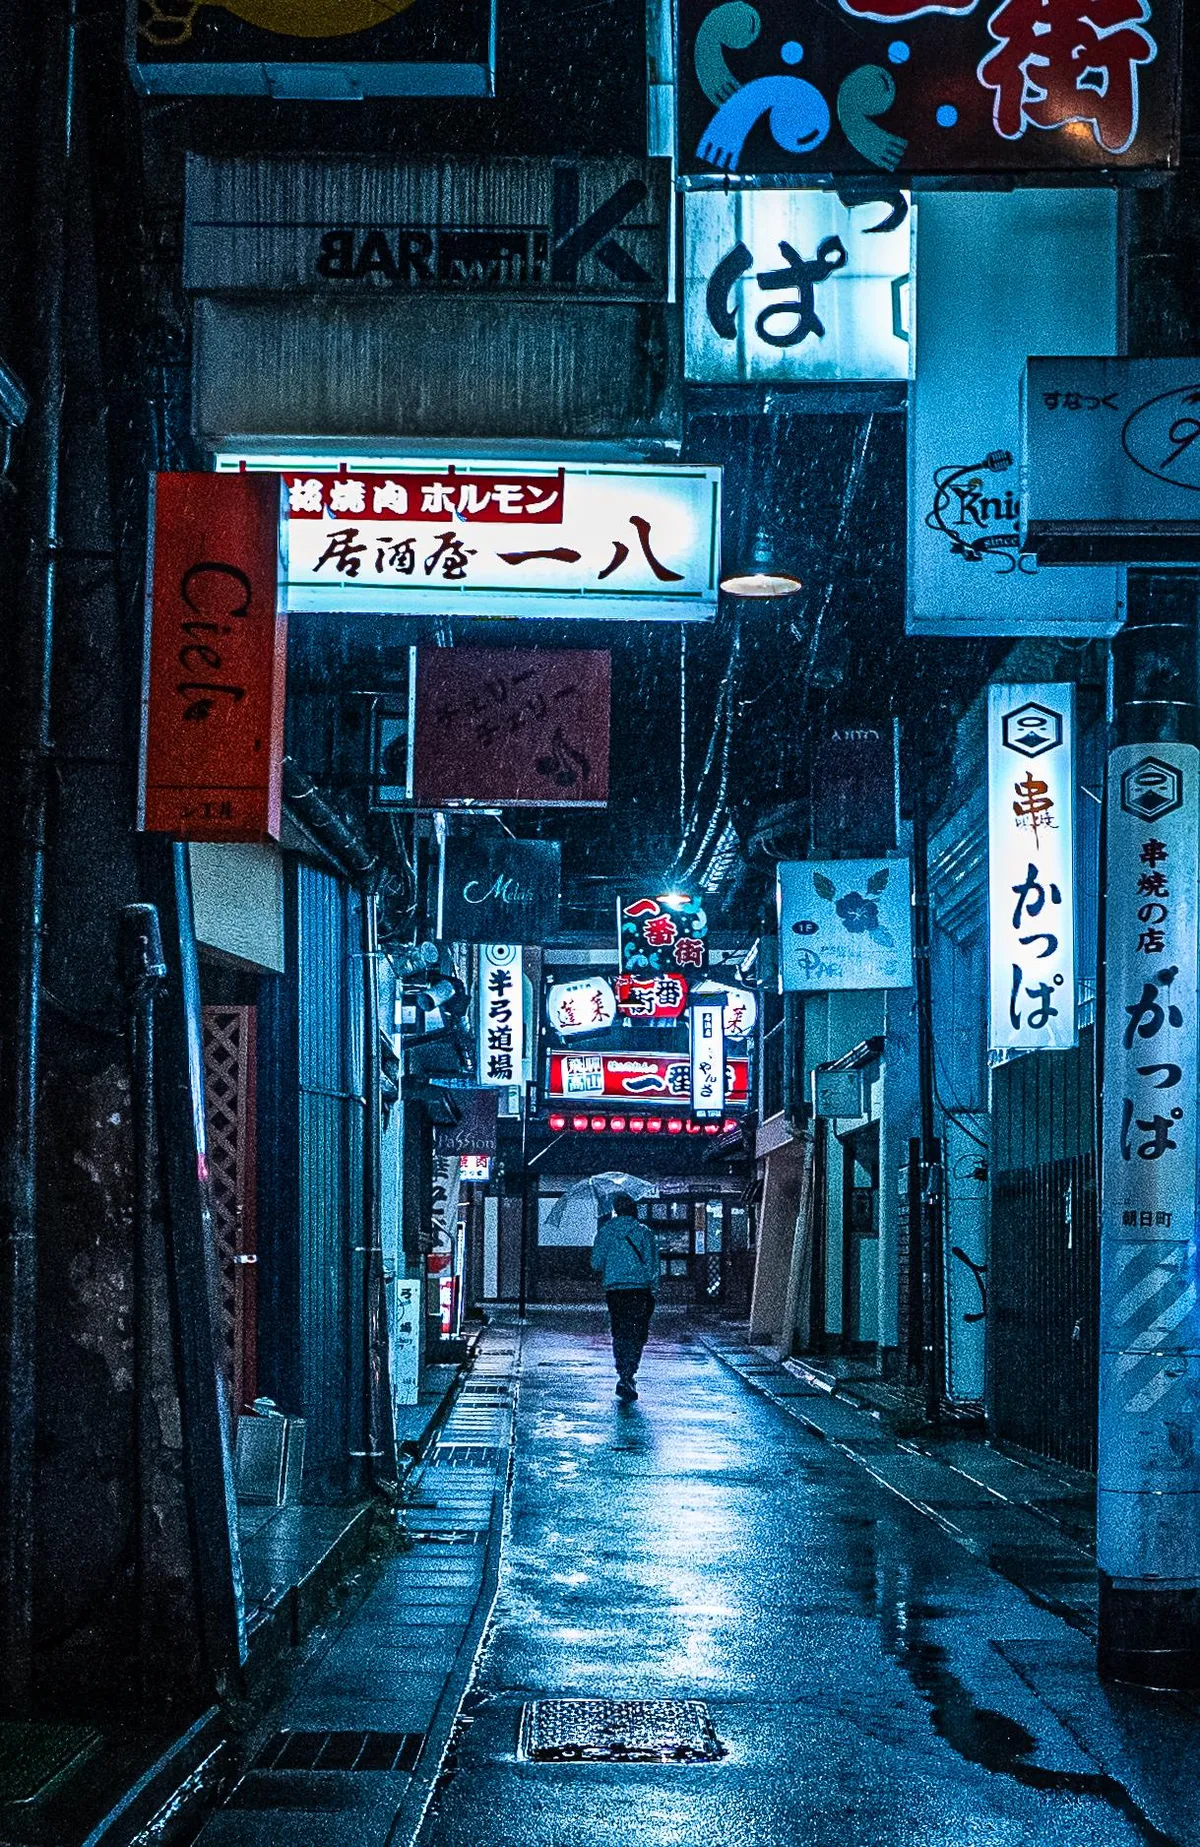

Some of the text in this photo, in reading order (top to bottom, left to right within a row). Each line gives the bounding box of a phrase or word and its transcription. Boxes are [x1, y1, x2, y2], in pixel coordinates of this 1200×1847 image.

[838, 0, 1158, 156] 街
[552, 167, 656, 283] K
[1042, 391, 1119, 411] すなっく
[420, 482, 559, 515] ホルモン
[953, 484, 1020, 530] Kni
[312, 514, 685, 582] 居酒屋 一八
[1012, 770, 1055, 851] 串
[797, 922, 814, 932] 1F
[1135, 838, 1171, 955] 串焼の店
[623, 898, 705, 968] 一番街
[1010, 862, 1064, 1031] かっぱ
[487, 969, 514, 1080] 半弓道場
[724, 1004, 747, 1034] 莱
[1121, 975, 1184, 1162] かっぱ
[1122, 1210, 1173, 1228] 朝日町
